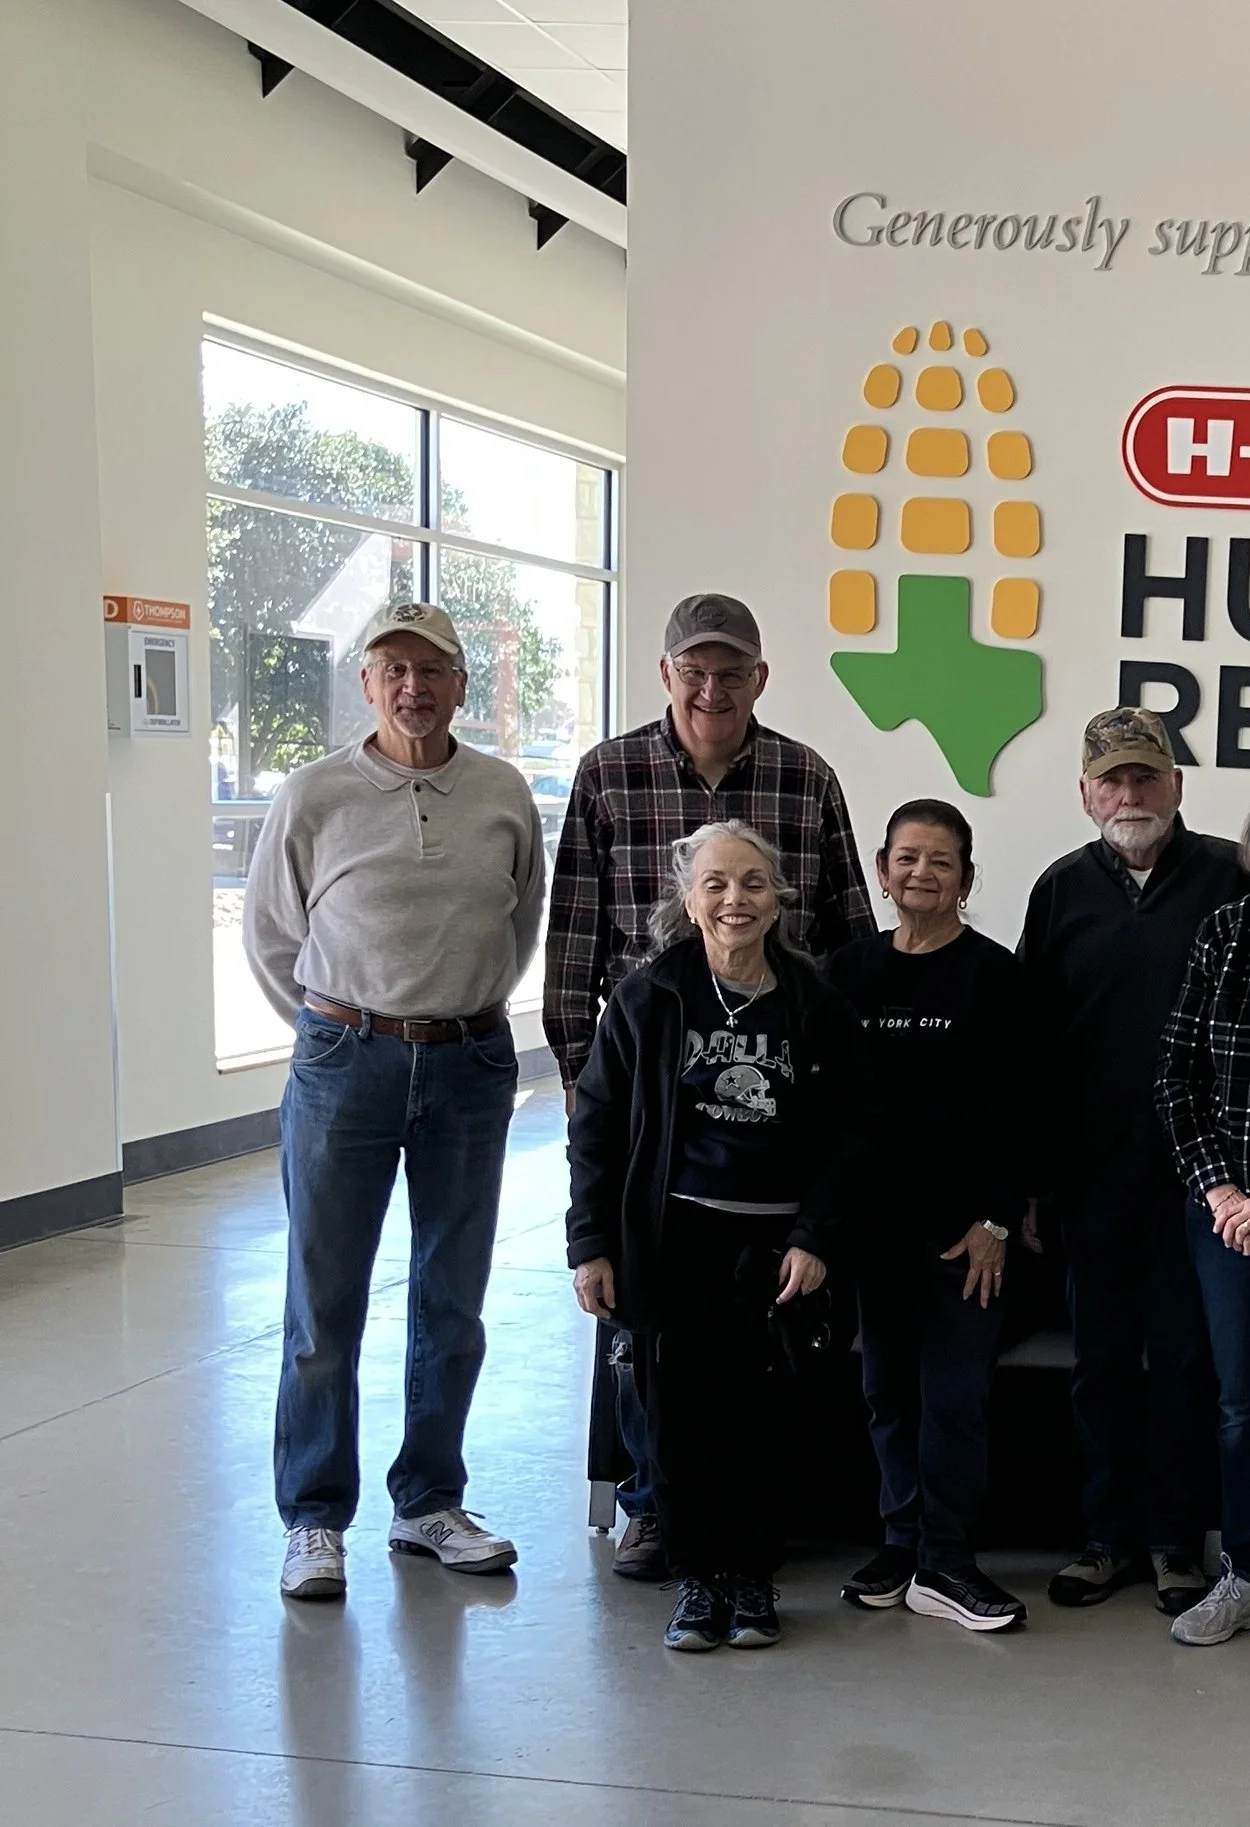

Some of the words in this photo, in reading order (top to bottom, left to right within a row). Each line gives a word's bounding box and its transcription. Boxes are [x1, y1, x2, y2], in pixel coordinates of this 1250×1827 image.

[832, 192, 1130, 271] Generously
[144, 604, 186, 620] THOMPSON
[879, 1017, 912, 1029] YORK
[919, 1017, 952, 1030] CITY
